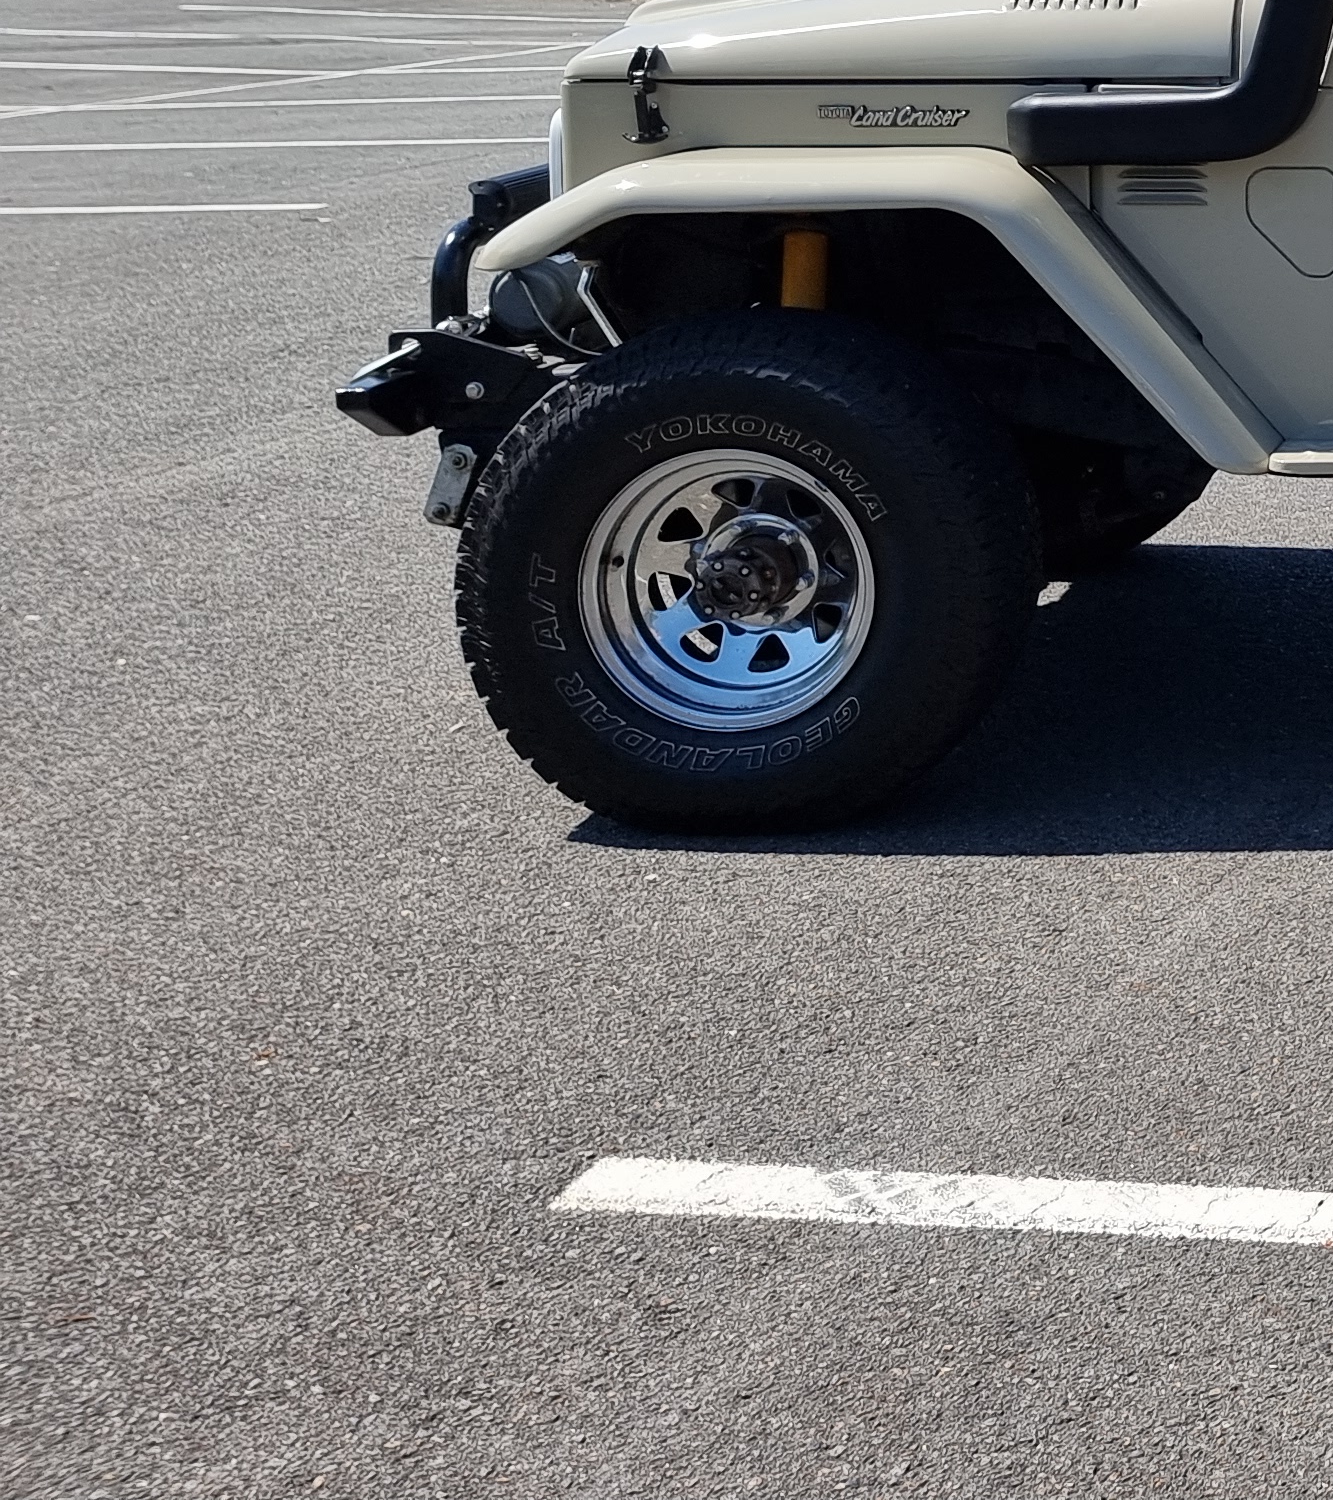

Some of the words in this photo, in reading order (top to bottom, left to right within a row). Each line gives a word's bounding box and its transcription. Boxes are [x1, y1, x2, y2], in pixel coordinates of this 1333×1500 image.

[817, 107, 850, 119] TOYOTA
[850, 106, 898, 127] Land
[896, 105, 968, 127] Cruiser
[624, 413, 889, 523] YOKOHAMA
[528, 552, 567, 652] A/T
[554, 669, 861, 773] GEOLANDAR
